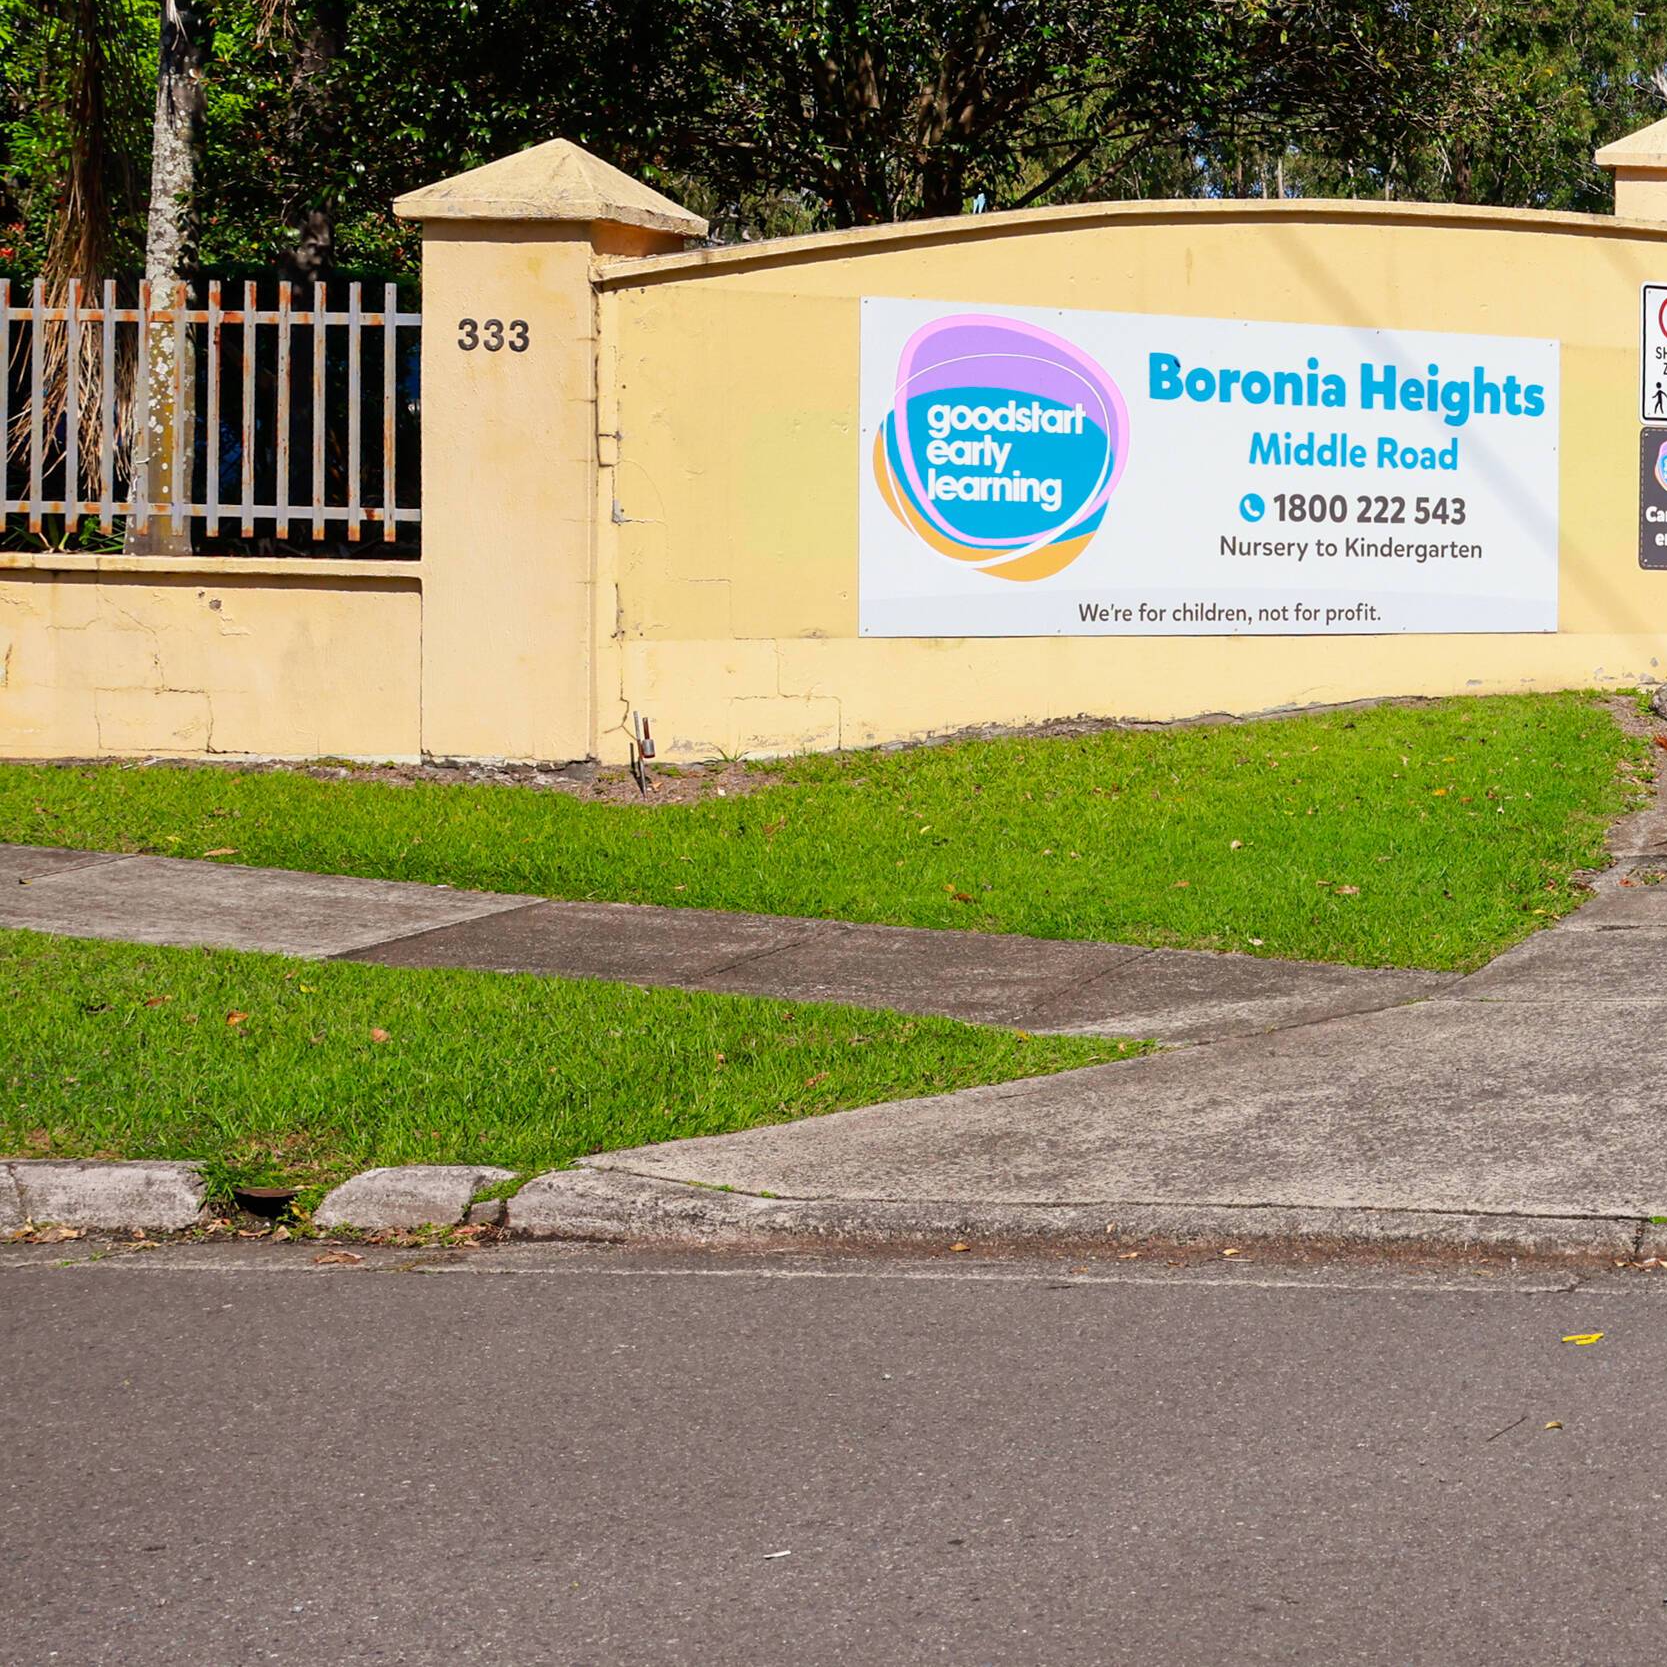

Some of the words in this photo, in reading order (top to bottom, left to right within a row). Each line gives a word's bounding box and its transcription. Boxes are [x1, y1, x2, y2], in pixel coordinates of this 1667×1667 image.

[458, 318, 529, 352] 333
[1149, 352, 1346, 407] Boronia
[1361, 363, 1544, 427] Heights
[927, 400, 1086, 438] goodstart
[926, 434, 1012, 474] early
[1249, 432, 1367, 468] Middle
[1377, 437, 1458, 470] Road
[928, 468, 1062, 512] learning
[1274, 494, 1347, 523] 1800
[1357, 496, 1405, 523] 222
[1414, 497, 1465, 525] 543
[1221, 536, 1308, 562] Nursery
[1315, 539, 1337, 556] to
[1346, 537, 1482, 563] Kindergarten
[1079, 604, 1132, 621] We're
[1139, 603, 1166, 621] for
[1172, 603, 1252, 625] children,
[1259, 606, 1288, 621] not
[1294, 603, 1320, 621] for
[1326, 603, 1381, 626] profit.
